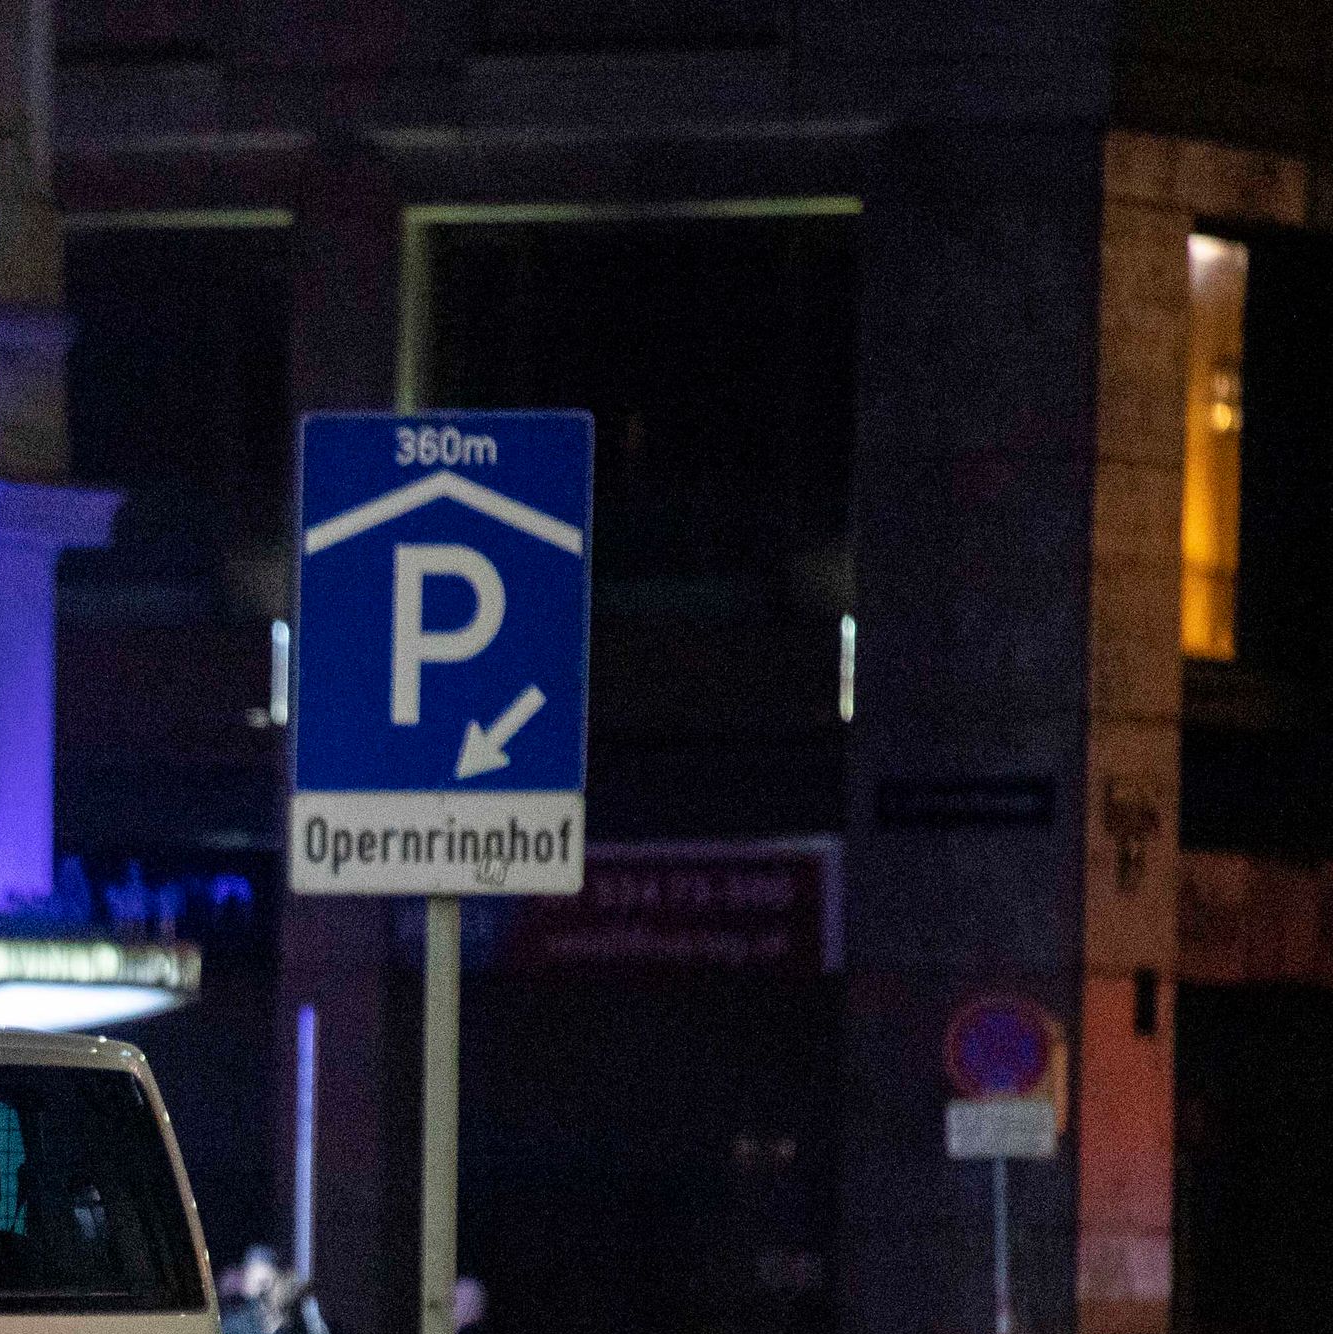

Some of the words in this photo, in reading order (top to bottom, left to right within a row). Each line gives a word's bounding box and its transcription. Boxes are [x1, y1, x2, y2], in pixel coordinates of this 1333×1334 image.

[395, 427, 498, 466] 360m
[390, 544, 506, 726] P
[305, 814, 575, 877] Opernringhof
